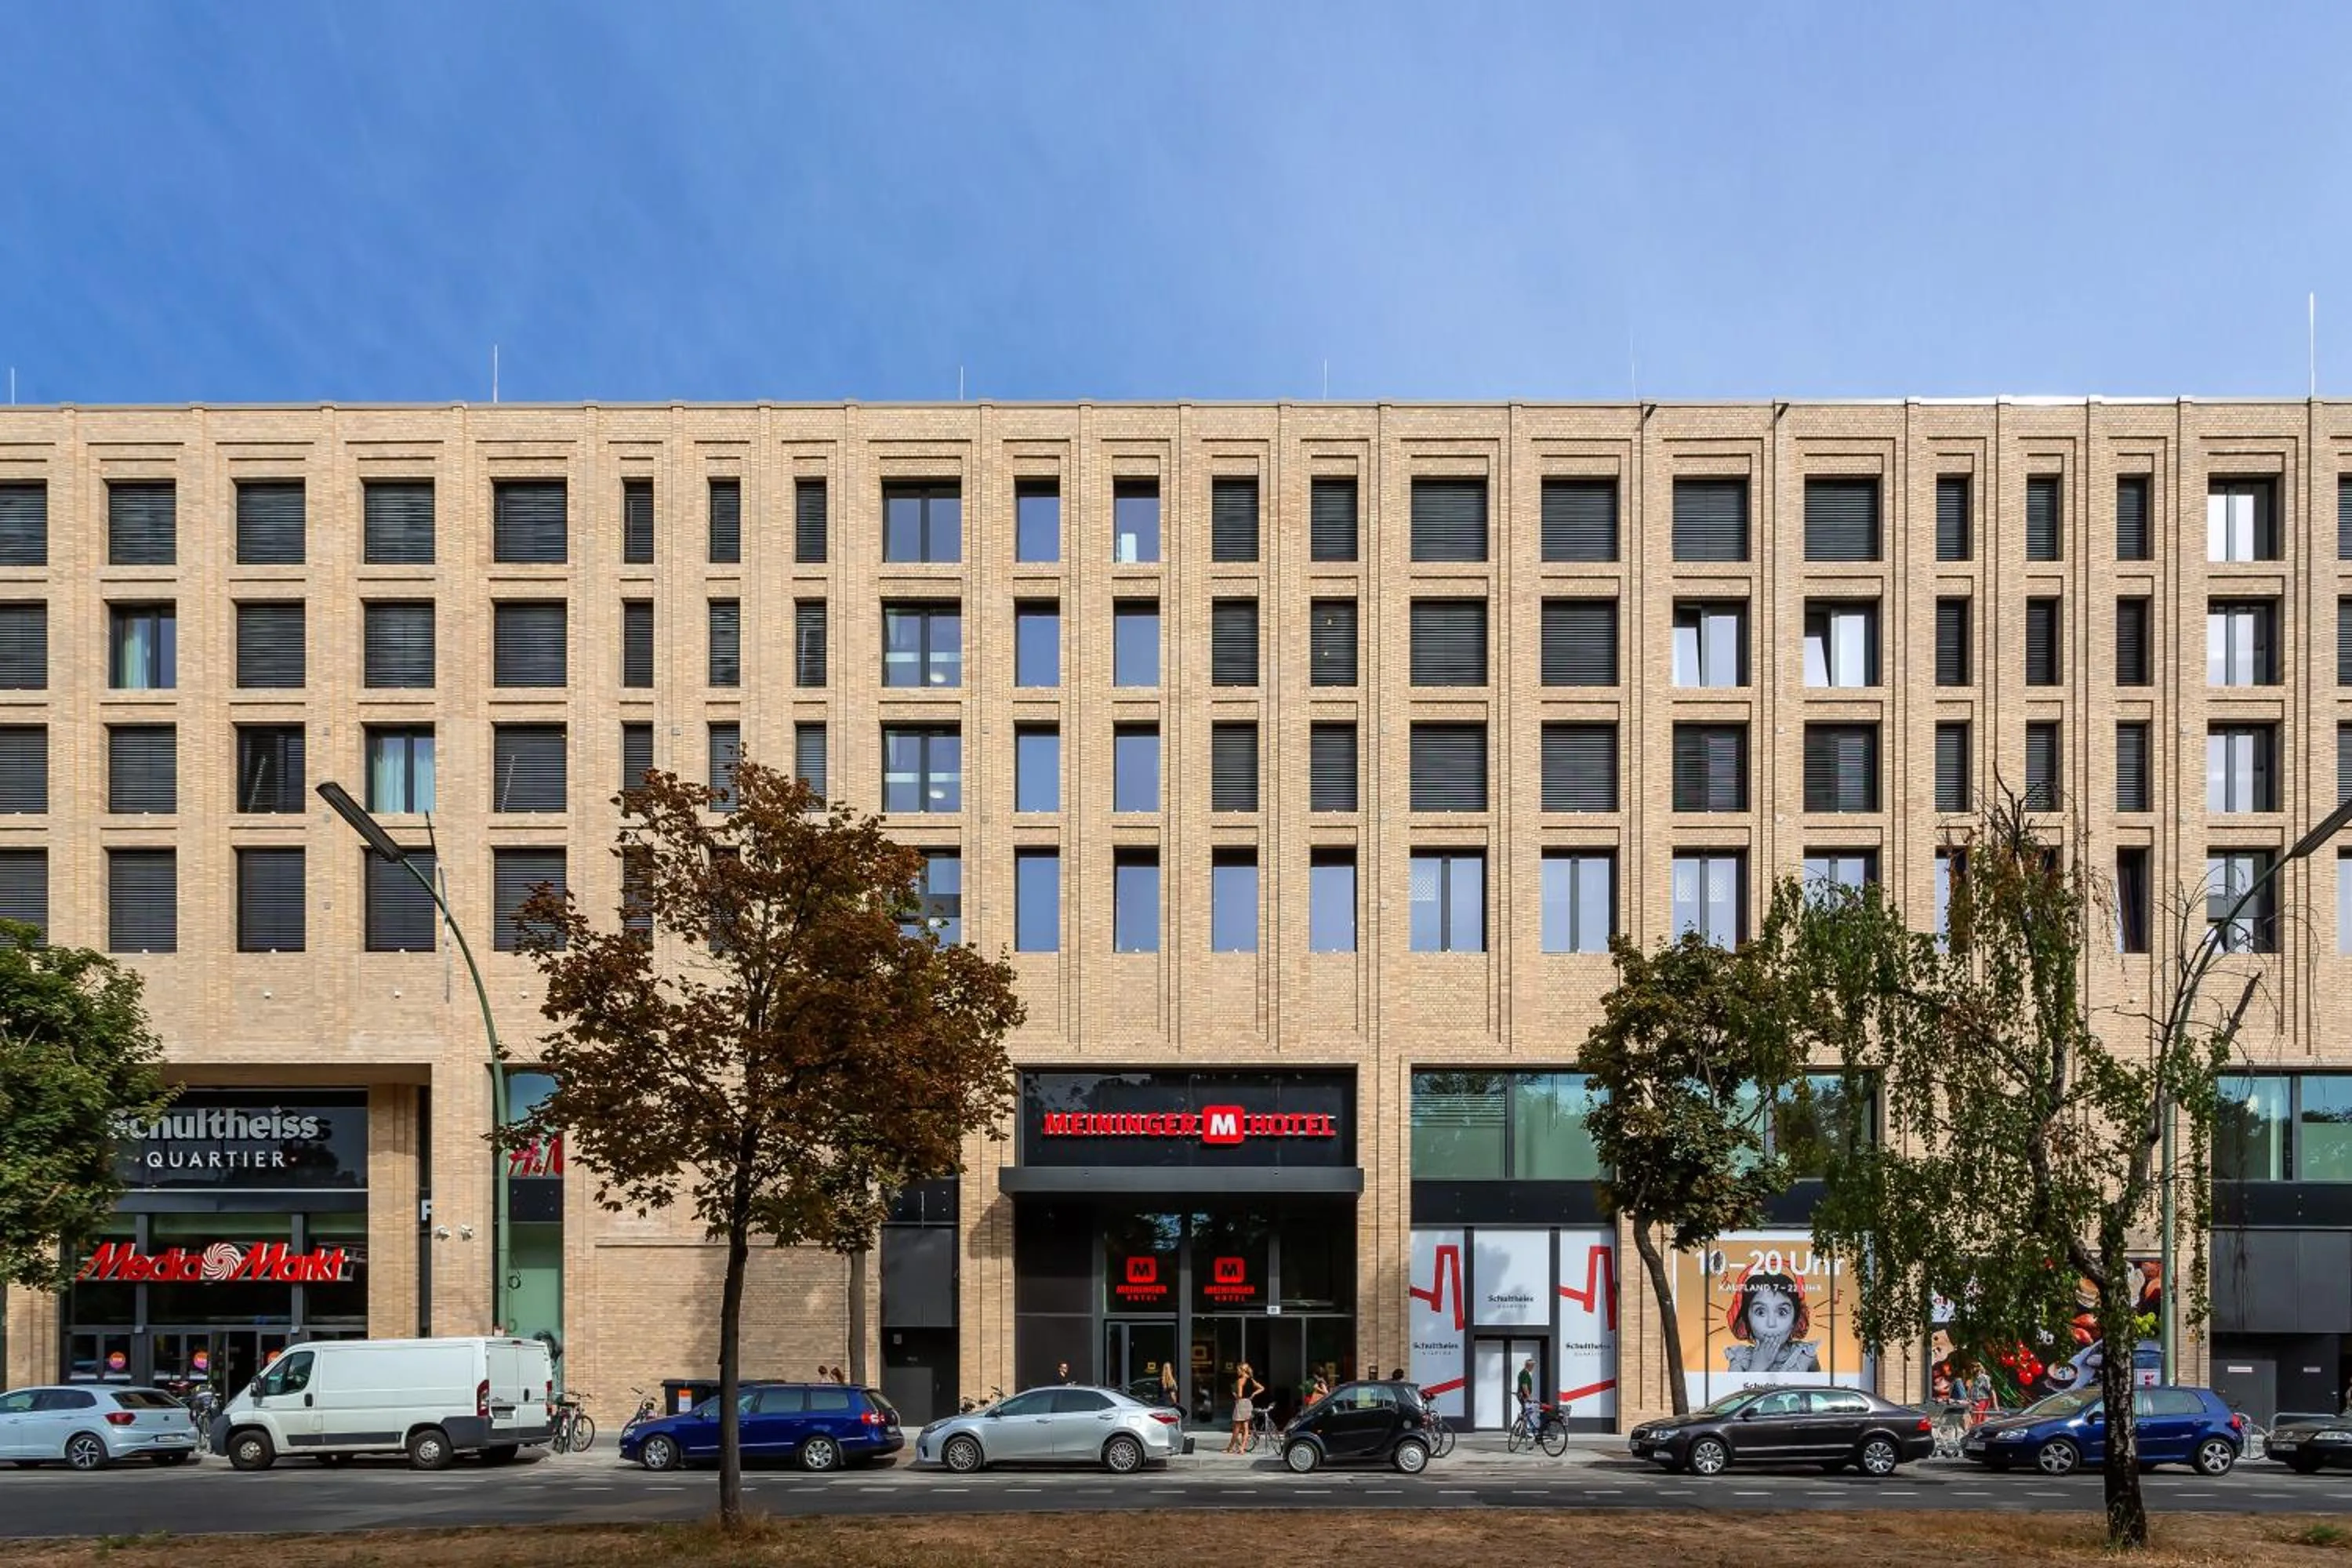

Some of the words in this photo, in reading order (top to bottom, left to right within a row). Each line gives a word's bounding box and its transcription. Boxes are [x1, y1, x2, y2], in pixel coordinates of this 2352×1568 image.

[1044, 1111, 1197, 1135] MEININGER
[1210, 1113, 1237, 1136] M
[1250, 1112, 1336, 1136] HOTEL
[147, 1151, 285, 1167] QUARTIER
[76, 1241, 204, 1280] Media
[235, 1241, 350, 1280] Markt
